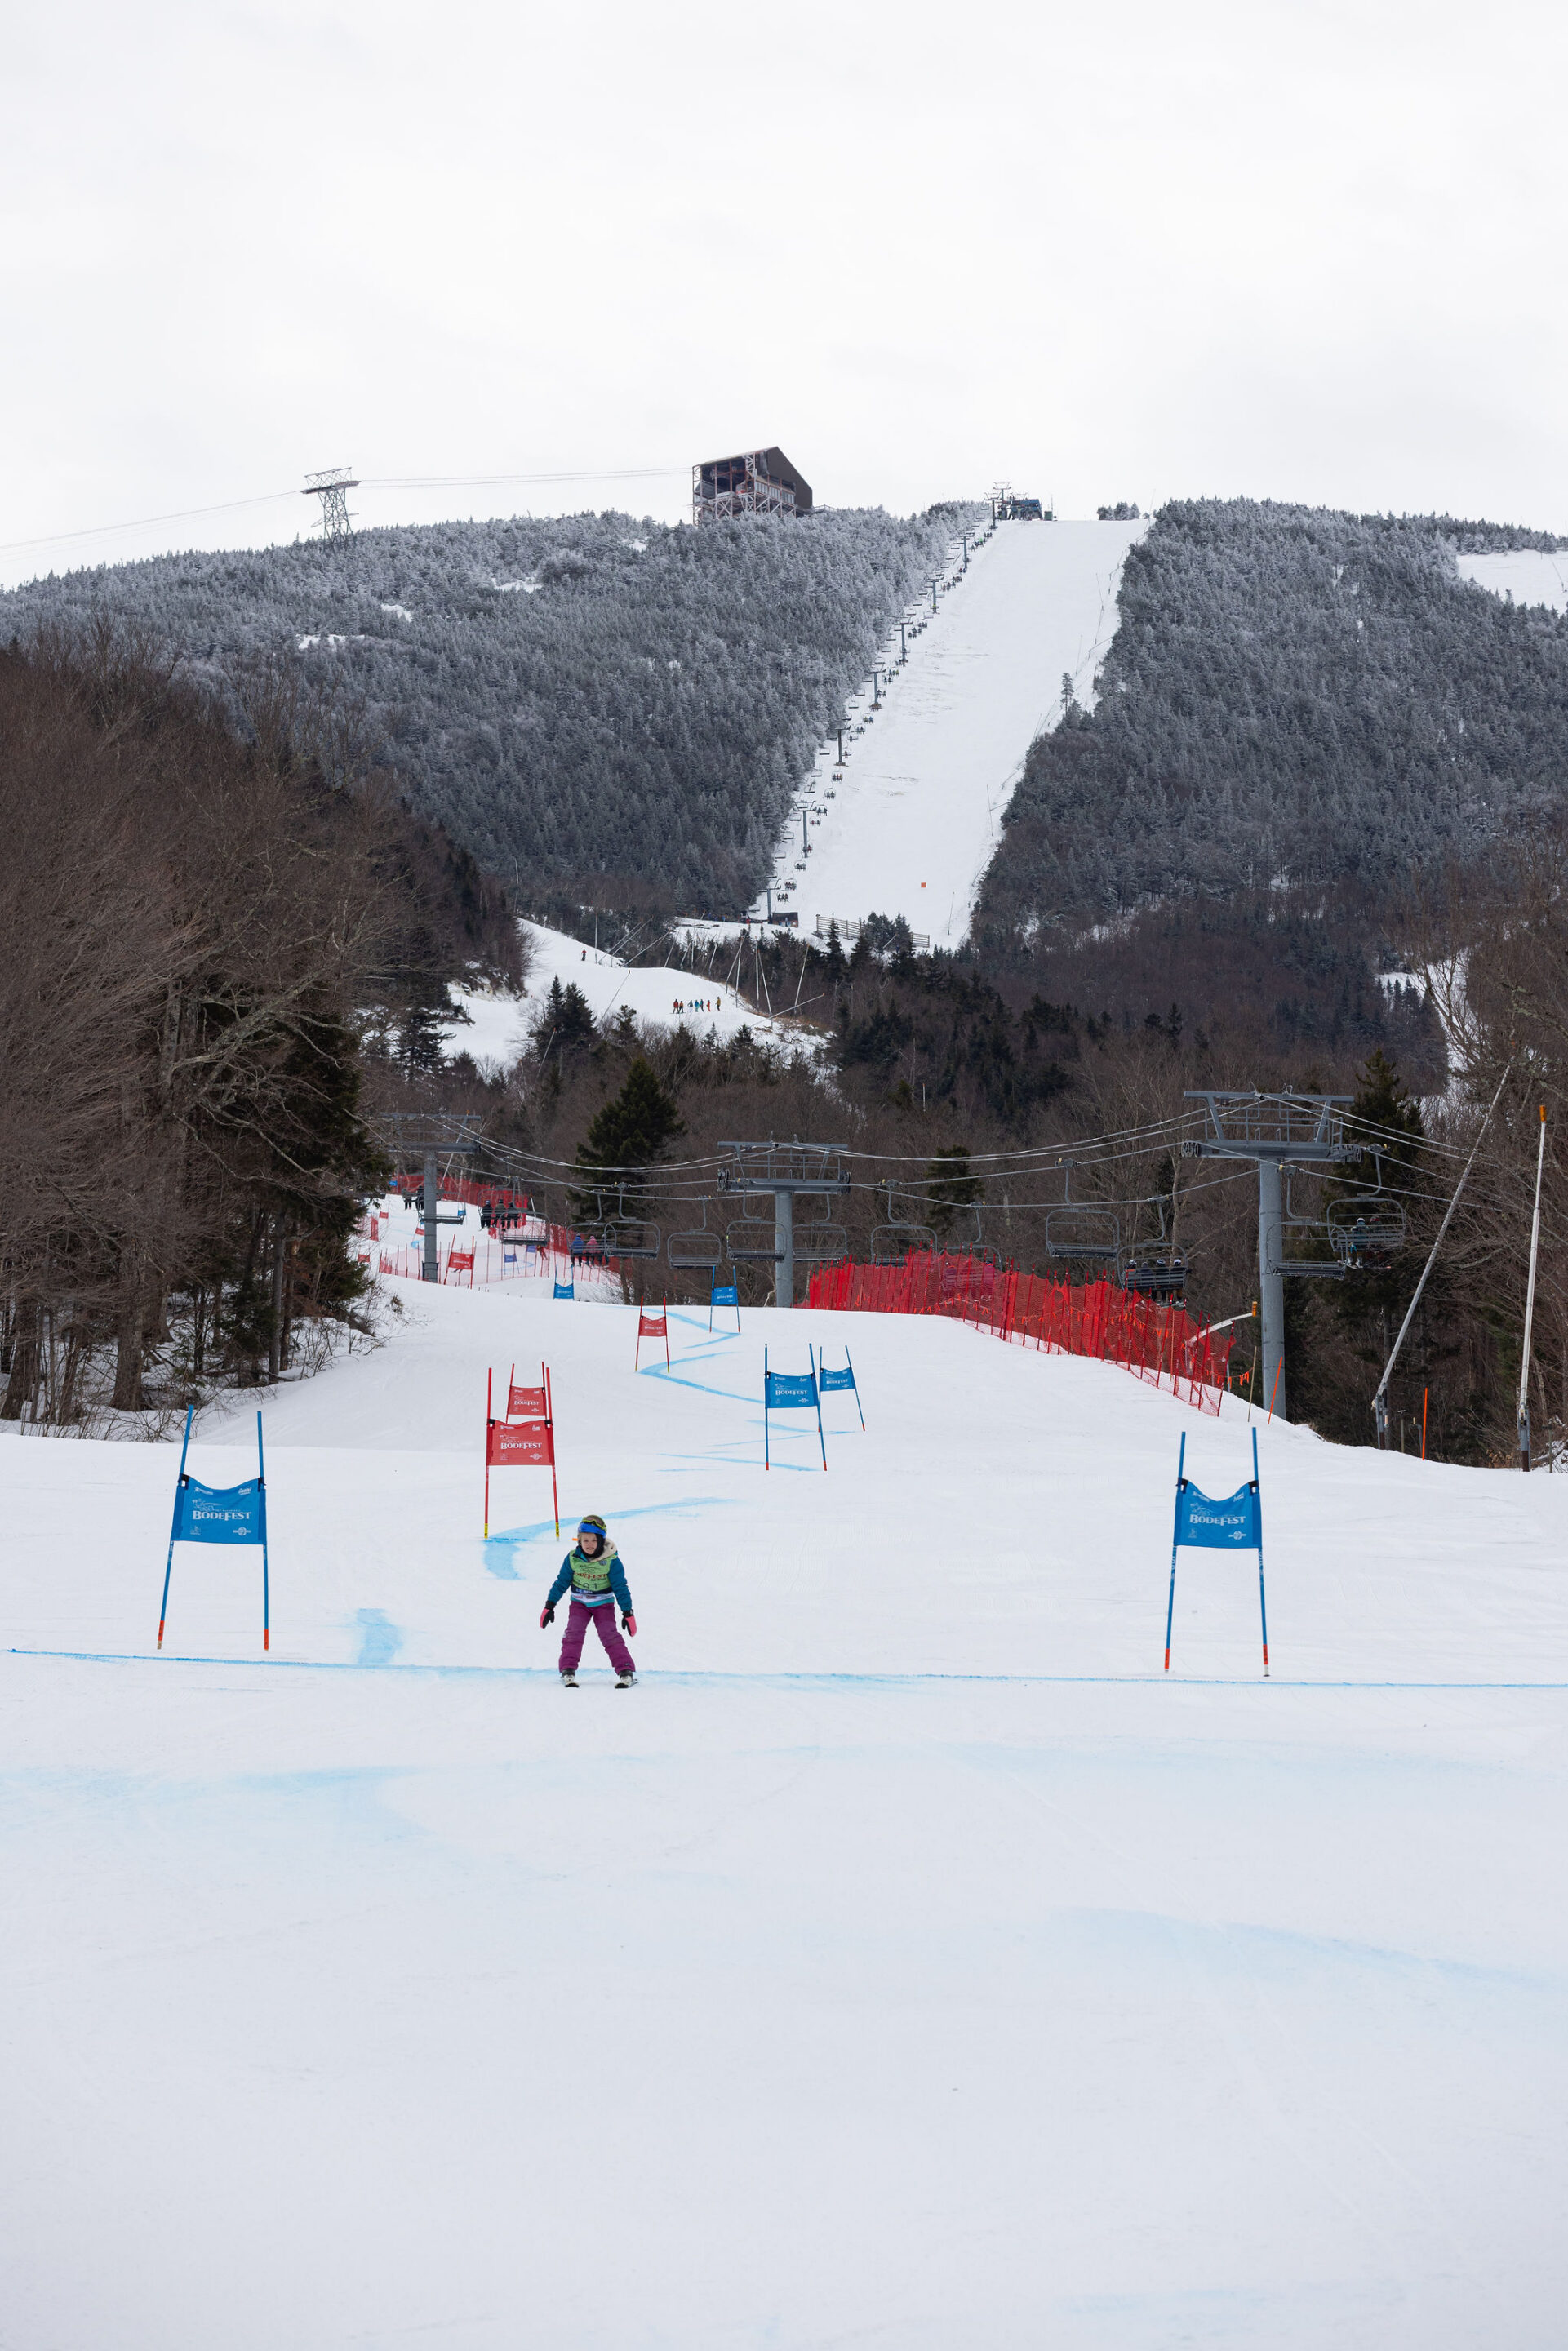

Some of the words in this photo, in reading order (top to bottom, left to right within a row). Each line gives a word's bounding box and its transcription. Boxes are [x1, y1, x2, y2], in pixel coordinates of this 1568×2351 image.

[500, 1442, 543, 1450] BODEFEST
[192, 1510, 252, 1521] BODEFEST
[1189, 1513, 1246, 1526] BODEFEST
